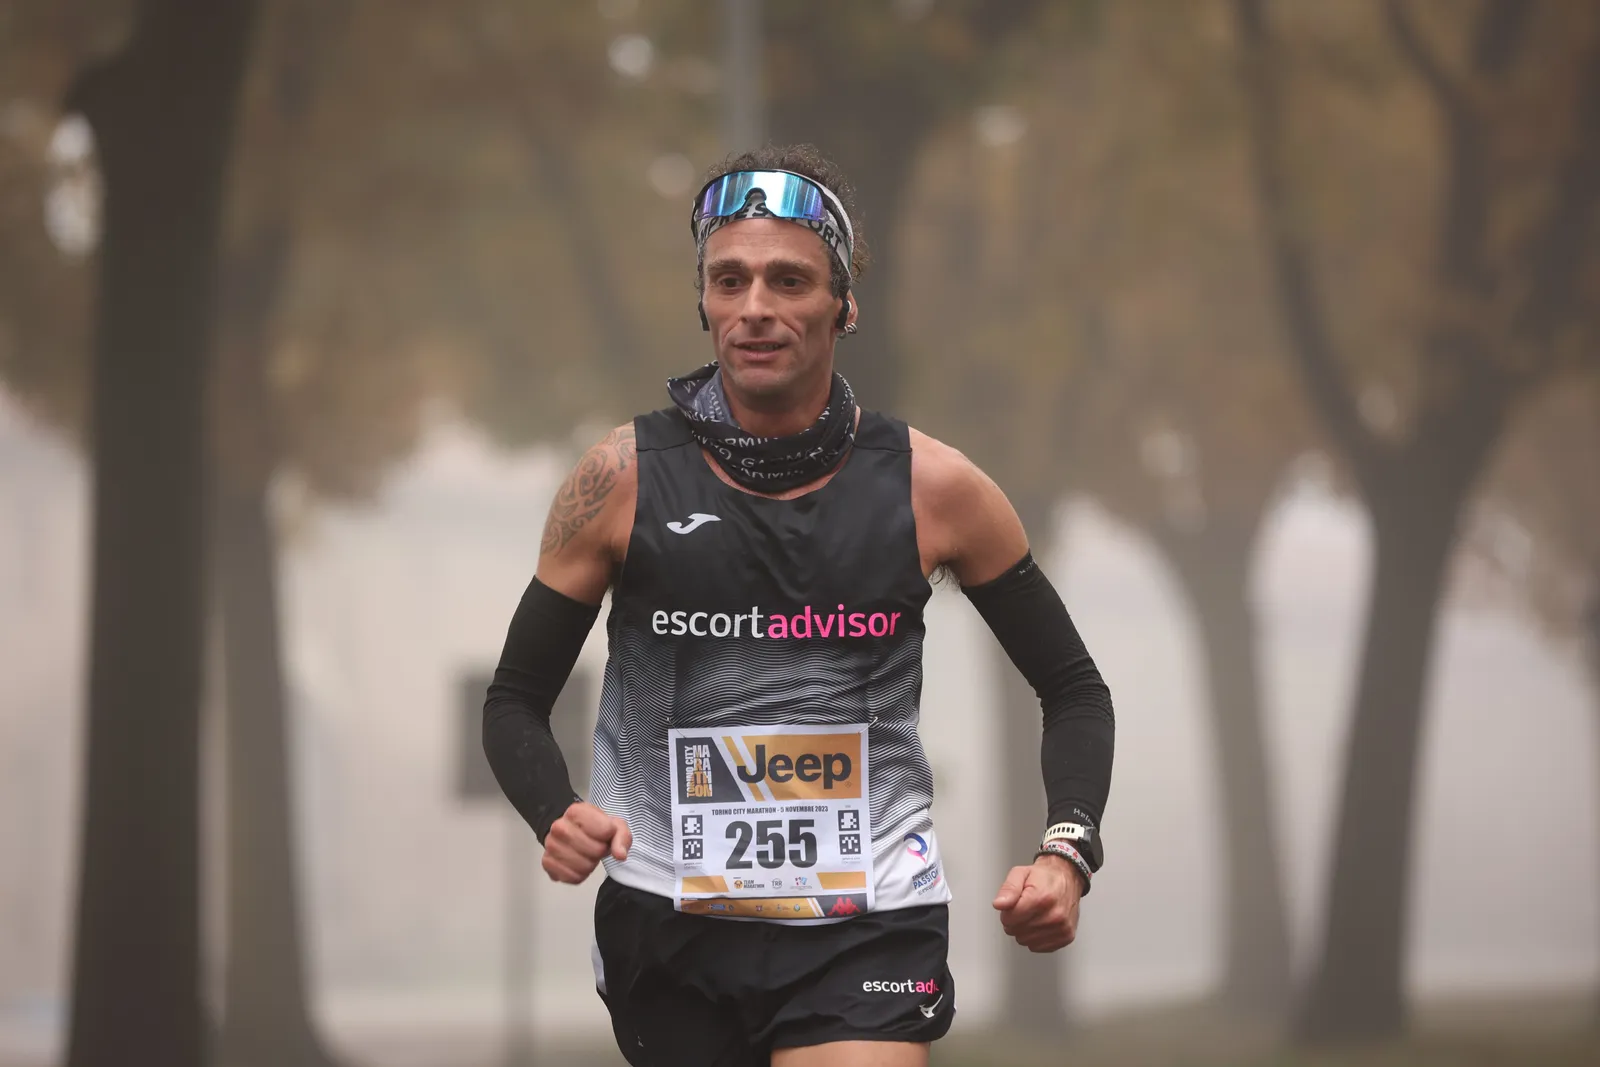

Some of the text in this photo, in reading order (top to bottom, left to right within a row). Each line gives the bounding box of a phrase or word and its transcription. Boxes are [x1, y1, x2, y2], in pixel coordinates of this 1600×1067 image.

[652, 604, 901, 639] escortadvisor
[684, 745, 695, 798] TORINO CITY
[737, 744, 852, 789] Jeep
[725, 819, 818, 870] 255
[863, 978, 939, 994] escortad
